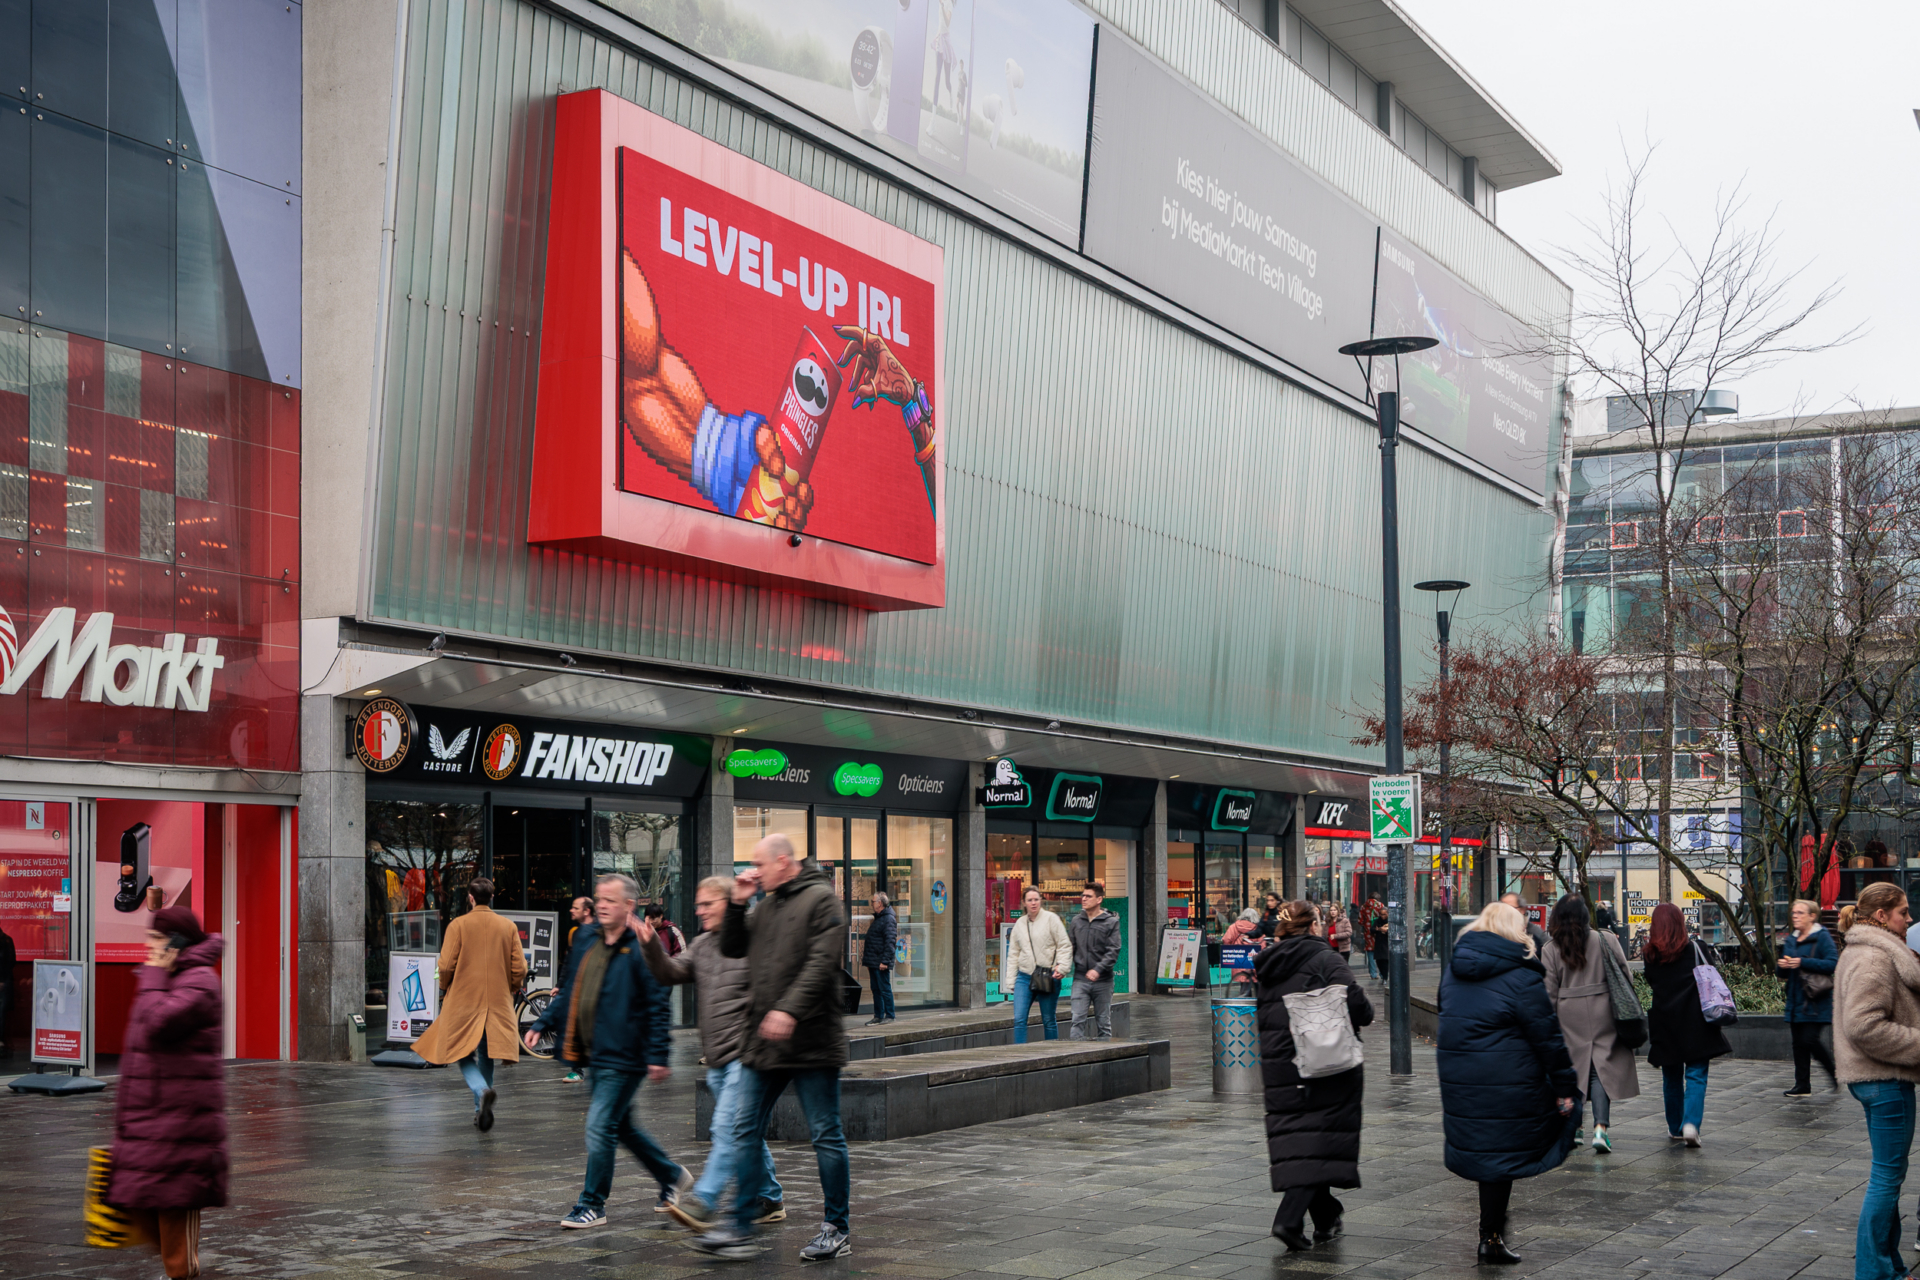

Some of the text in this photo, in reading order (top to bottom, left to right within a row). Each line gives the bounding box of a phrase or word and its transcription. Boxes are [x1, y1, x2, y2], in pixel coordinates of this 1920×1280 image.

[1177, 157, 1317, 278] Kies hier jouw Samsung
[1161, 196, 1323, 321] bij MediaMarkt Tech Village
[1382, 240, 1415, 276] SAMSUNG
[660, 197, 910, 347] LEVEL-UP IRL
[1373, 368, 1389, 390] No.1
[1482, 348, 1544, 403] Upscale Every Moment
[1489, 384, 1497, 398] New
[1509, 397, 1528, 421] Samsung
[1532, 411, 1538, 423] TV
[780, 386, 818, 449] PRINGLES
[1493, 412, 1527, 446] Neo QLED 8K
[781, 424, 803, 456] ORIGINAL
[1, 606, 225, 712] Markt
[359, 702, 406, 726] FEYENOORD
[371, 718, 392, 753] F
[489, 726, 520, 746] FEYENOORD
[359, 744, 406, 770] ROTTERDAM
[493, 739, 510, 765] F
[521, 731, 674, 786] FANSHOP
[729, 757, 777, 768] Specsavers
[423, 761, 462, 772] CASTORE
[484, 759, 516, 778] ROTTERDAM
[841, 773, 880, 786] Specsavers
[898, 774, 944, 795] Opticiens
[986, 789, 1023, 802] Normal
[1064, 787, 1097, 809] Normal
[1226, 801, 1252, 821] Normal
[1316, 802, 1348, 826] KFC
